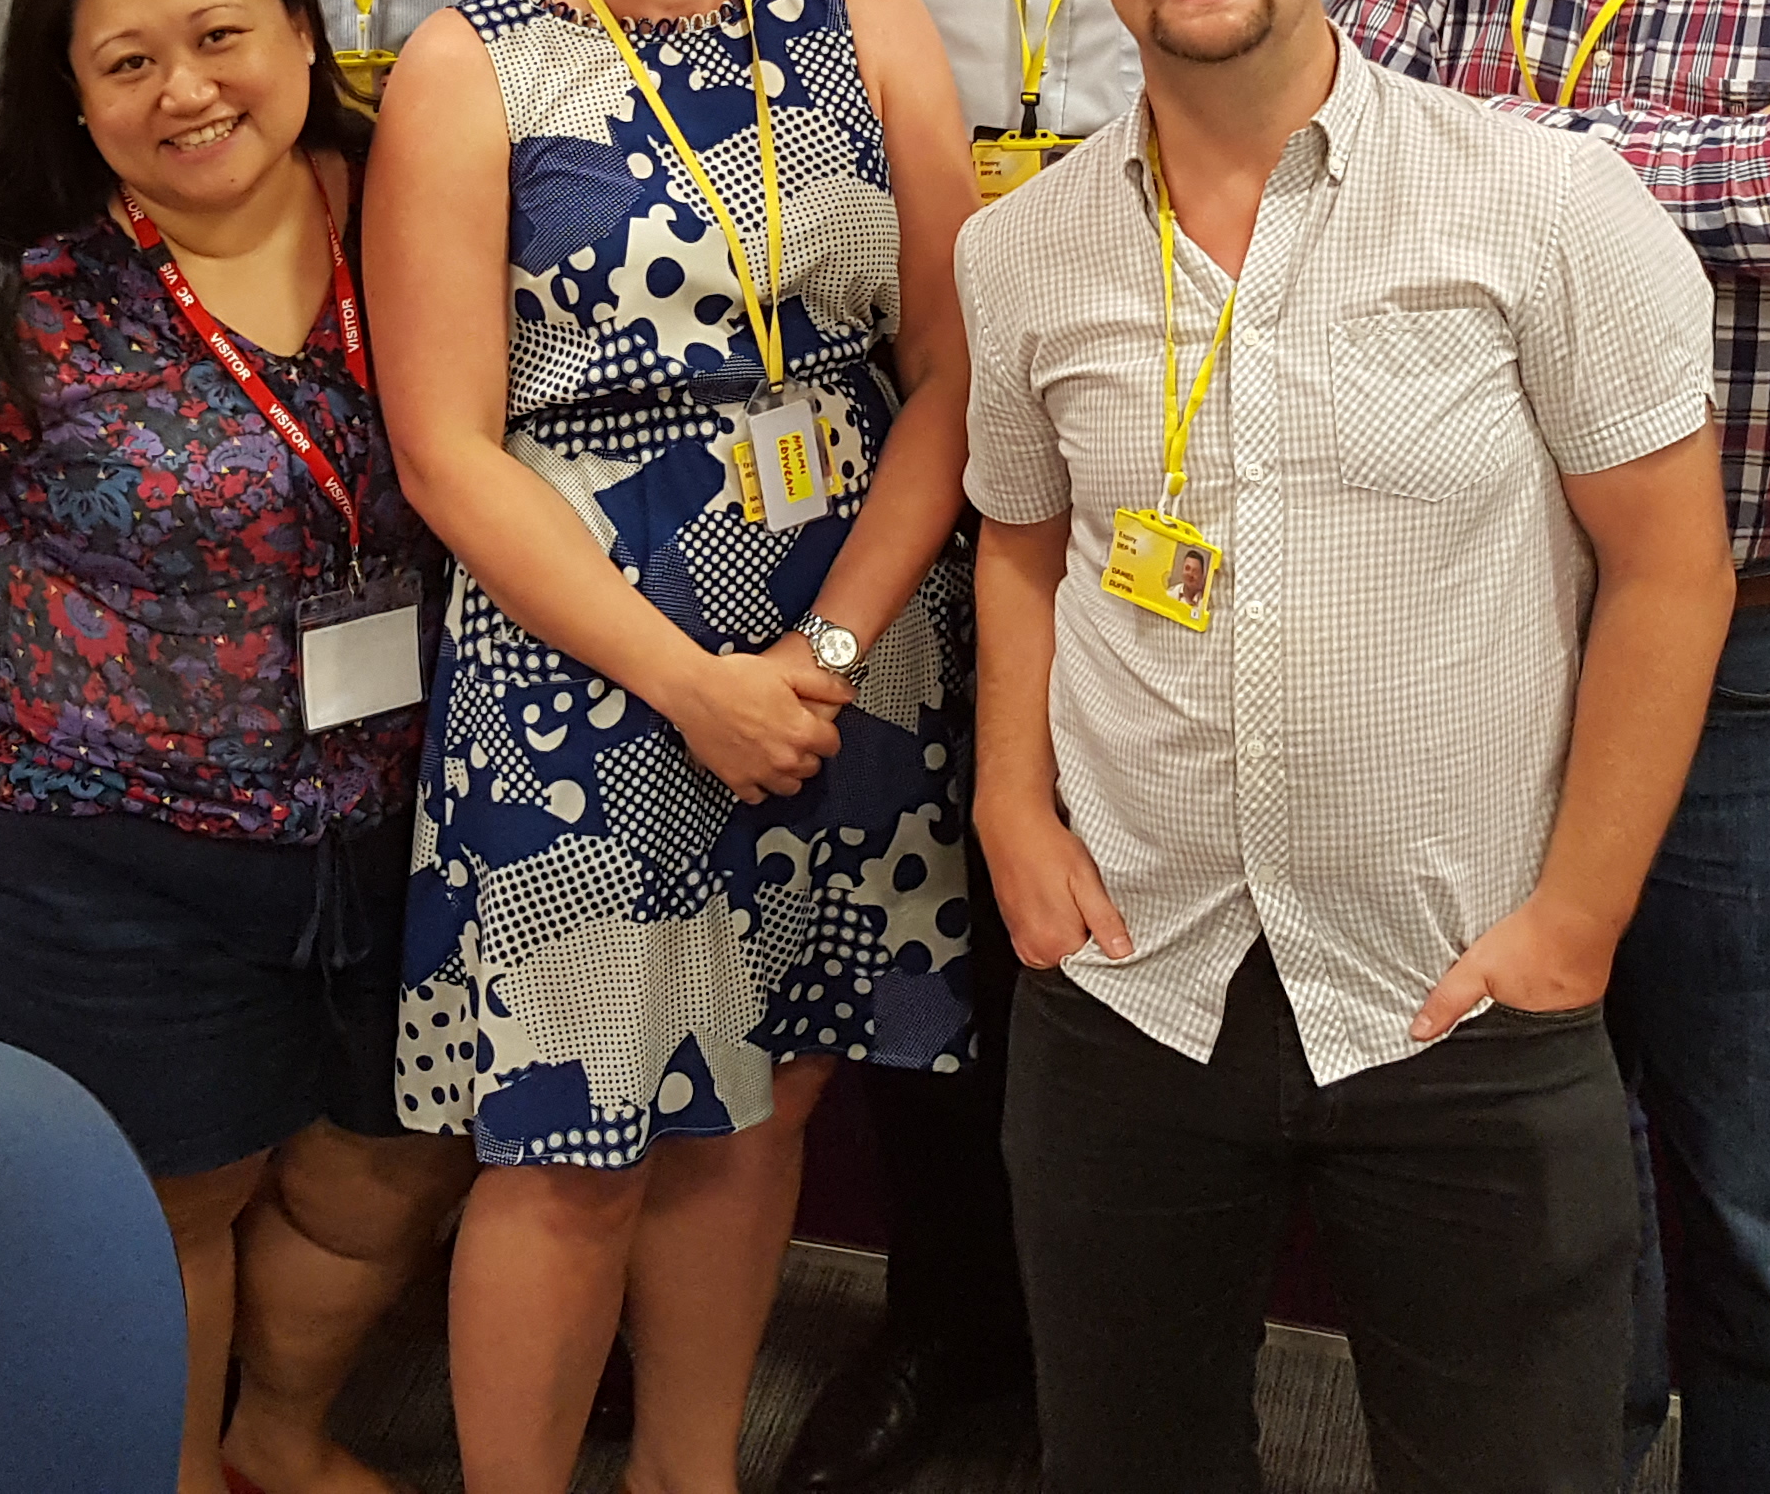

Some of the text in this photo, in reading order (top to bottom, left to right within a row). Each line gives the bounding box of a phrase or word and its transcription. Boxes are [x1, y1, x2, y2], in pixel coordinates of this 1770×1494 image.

[341, 298, 360, 354] VISITOR
[210, 332, 252, 382] VISITOR
[269, 403, 311, 454] VISITOR
[779, 439, 796, 497] EDYVEAN
